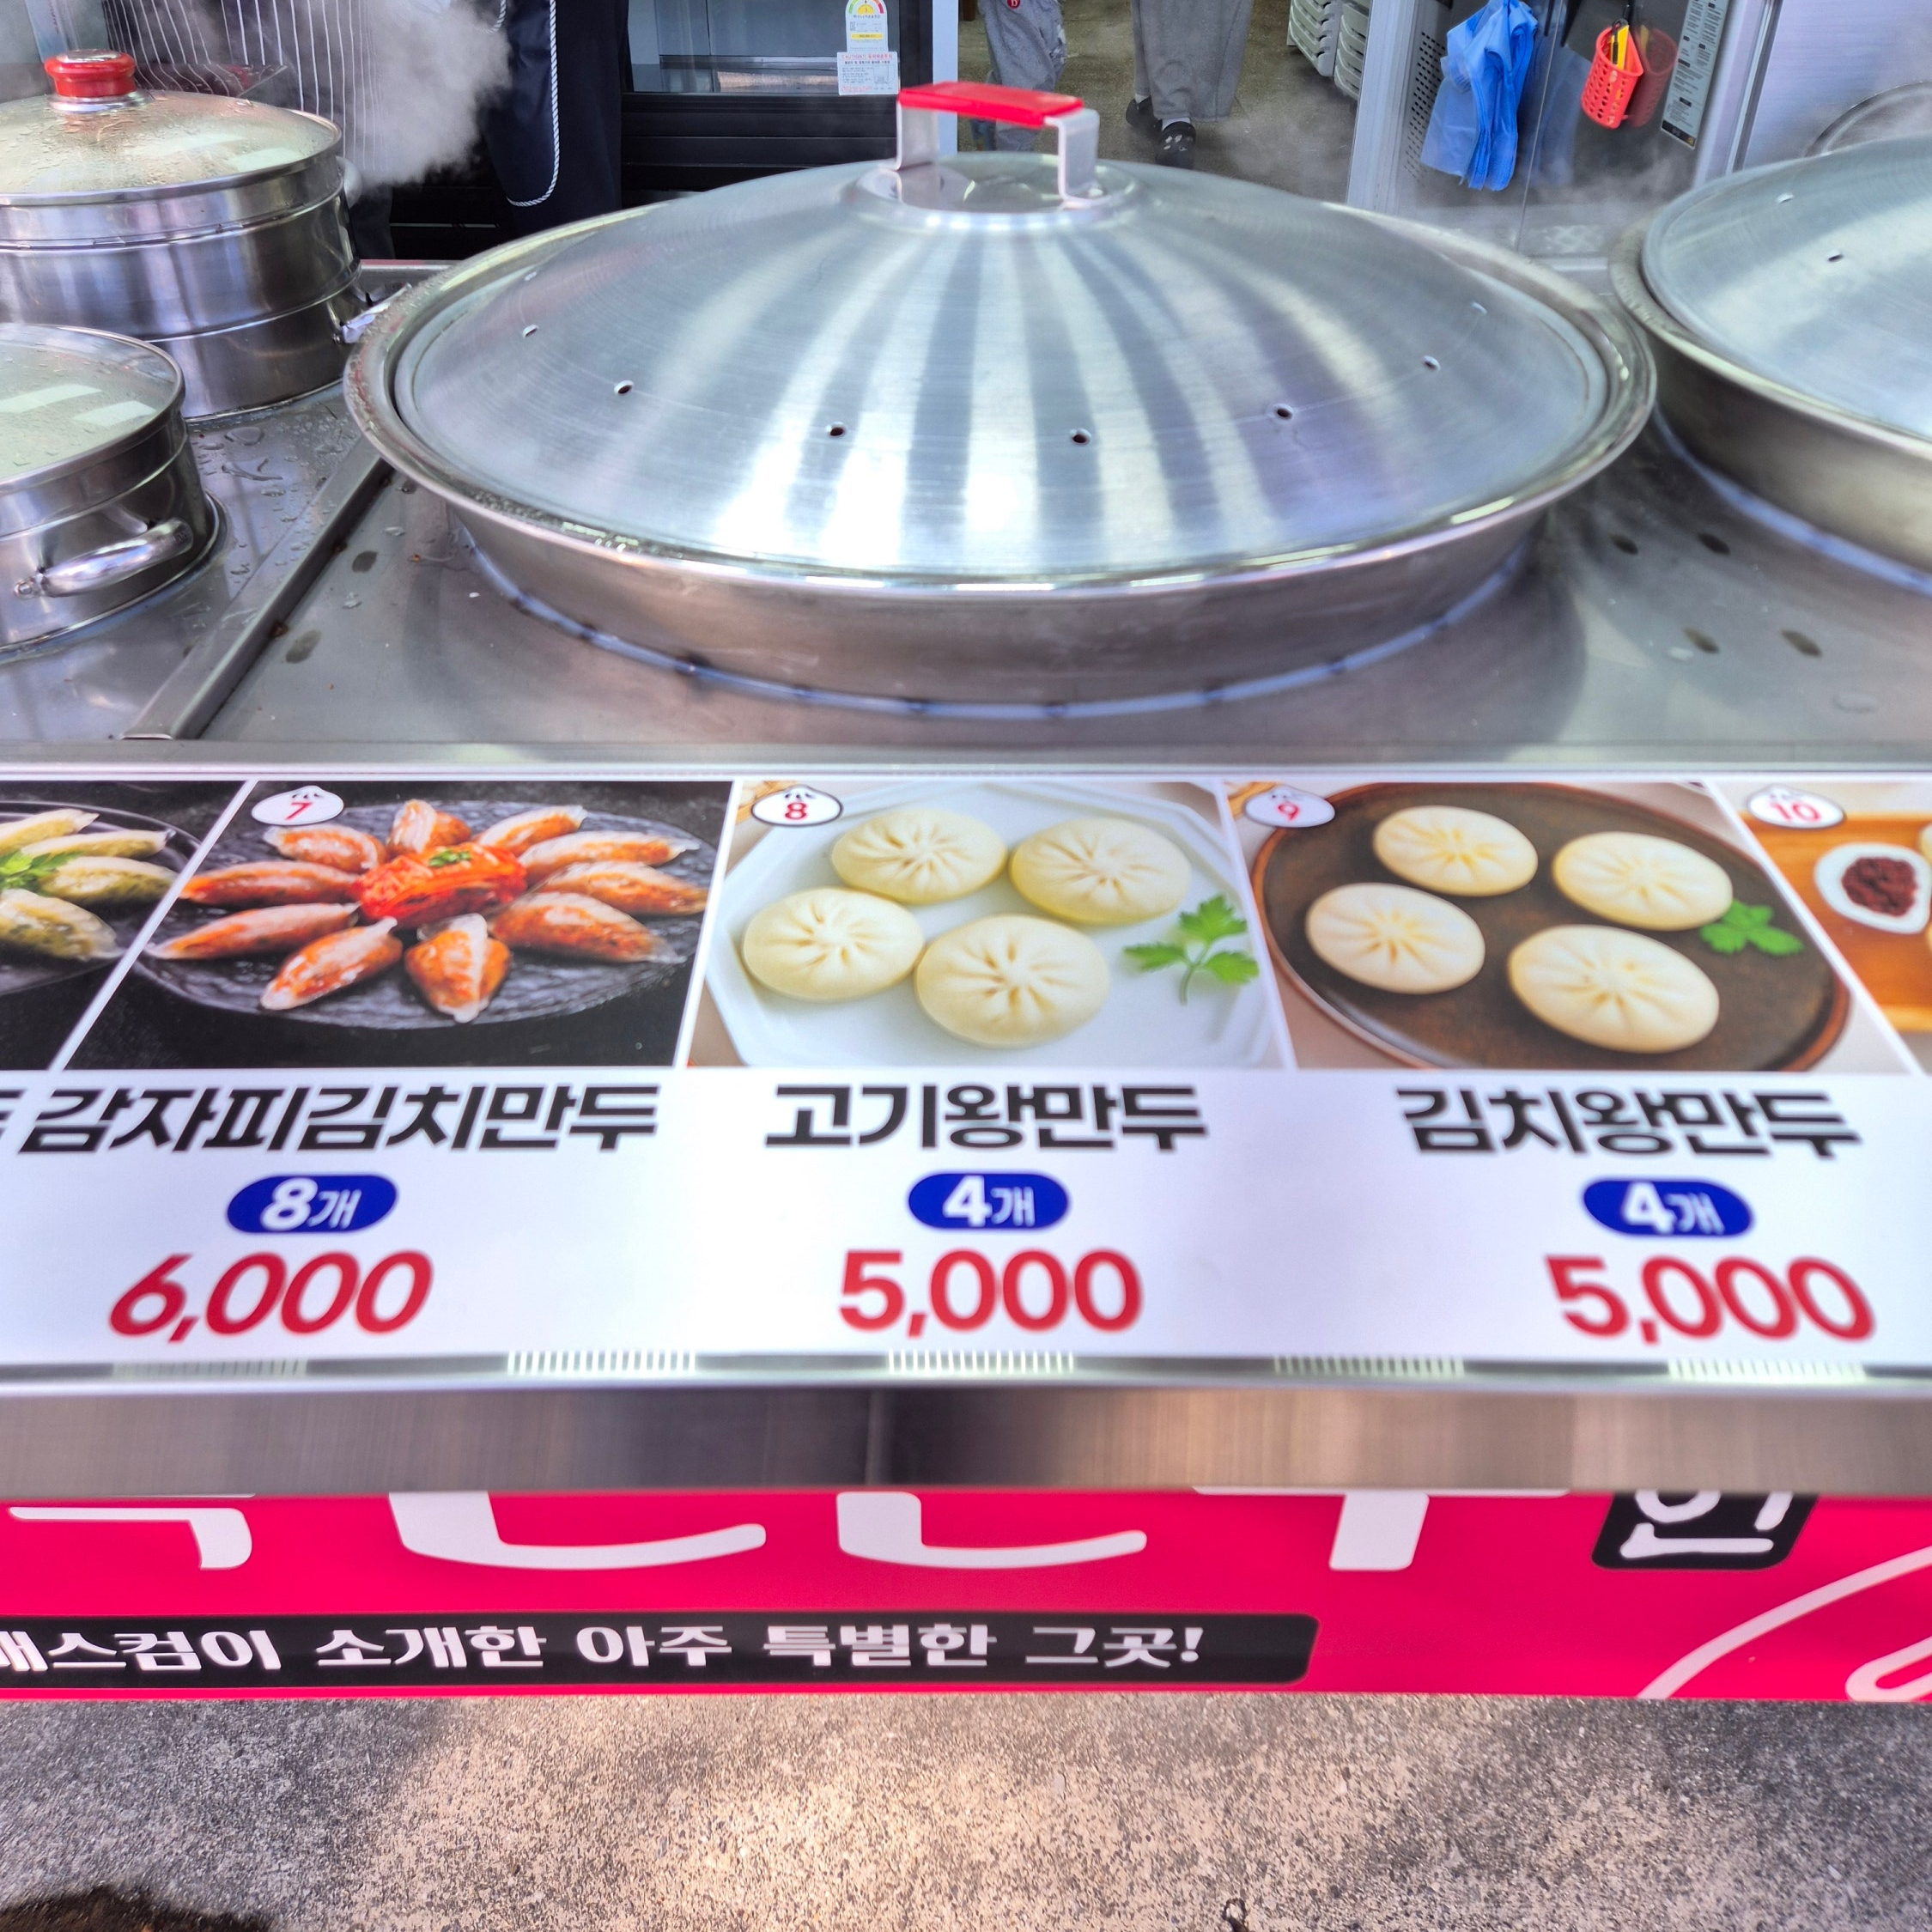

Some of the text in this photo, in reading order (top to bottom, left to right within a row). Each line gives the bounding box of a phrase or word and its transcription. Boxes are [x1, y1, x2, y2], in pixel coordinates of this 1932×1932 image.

[285, 801, 313, 821] 7
[784, 801, 808, 821] 8
[1276, 802, 1300, 822] 9
[1769, 801, 1820, 823] 10
[18, 1086, 659, 1152] 감자피김치만두
[766, 1085, 1206, 1151] 고기왕만두
[1397, 1089, 1860, 1157] 김치왕만두
[262, 1177, 361, 1230] 8개
[944, 1176, 1036, 1227] 4개
[1622, 1182, 1724, 1233] 4개
[109, 1250, 434, 1343] 6,000
[839, 1249, 1142, 1339] 5,000
[1546, 1256, 1874, 1345] 5,000
[316, 1625, 547, 1668] 소개한
[577, 1625, 732, 1667] 아주
[763, 1624, 998, 1667] 특별한
[1026, 1627, 1204, 1668] 그곳!
